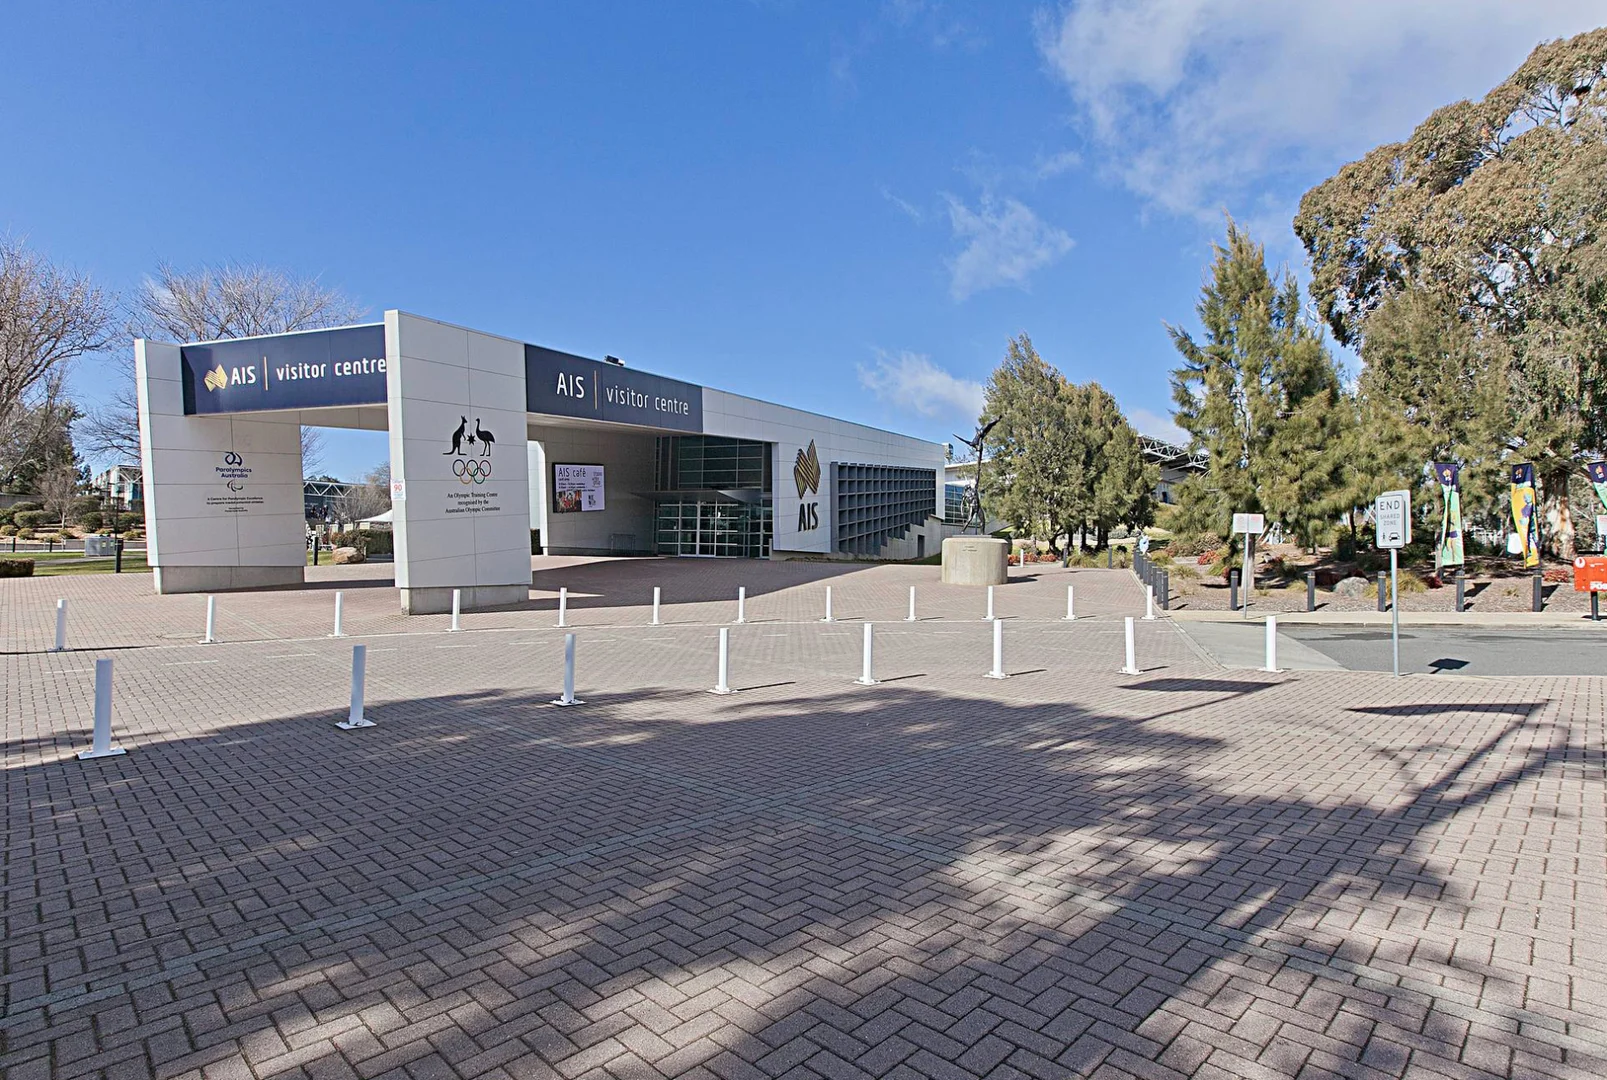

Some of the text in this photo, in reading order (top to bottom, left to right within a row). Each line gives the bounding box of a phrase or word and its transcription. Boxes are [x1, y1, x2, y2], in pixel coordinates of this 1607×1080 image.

[231, 357, 386, 385] AIS visitor centre
[556, 372, 689, 415] AIS visitor centre
[558, 467, 570, 477] AIS
[572, 467, 586, 477] café
[798, 502, 819, 532] AIS
[1380, 500, 1400, 510] END
